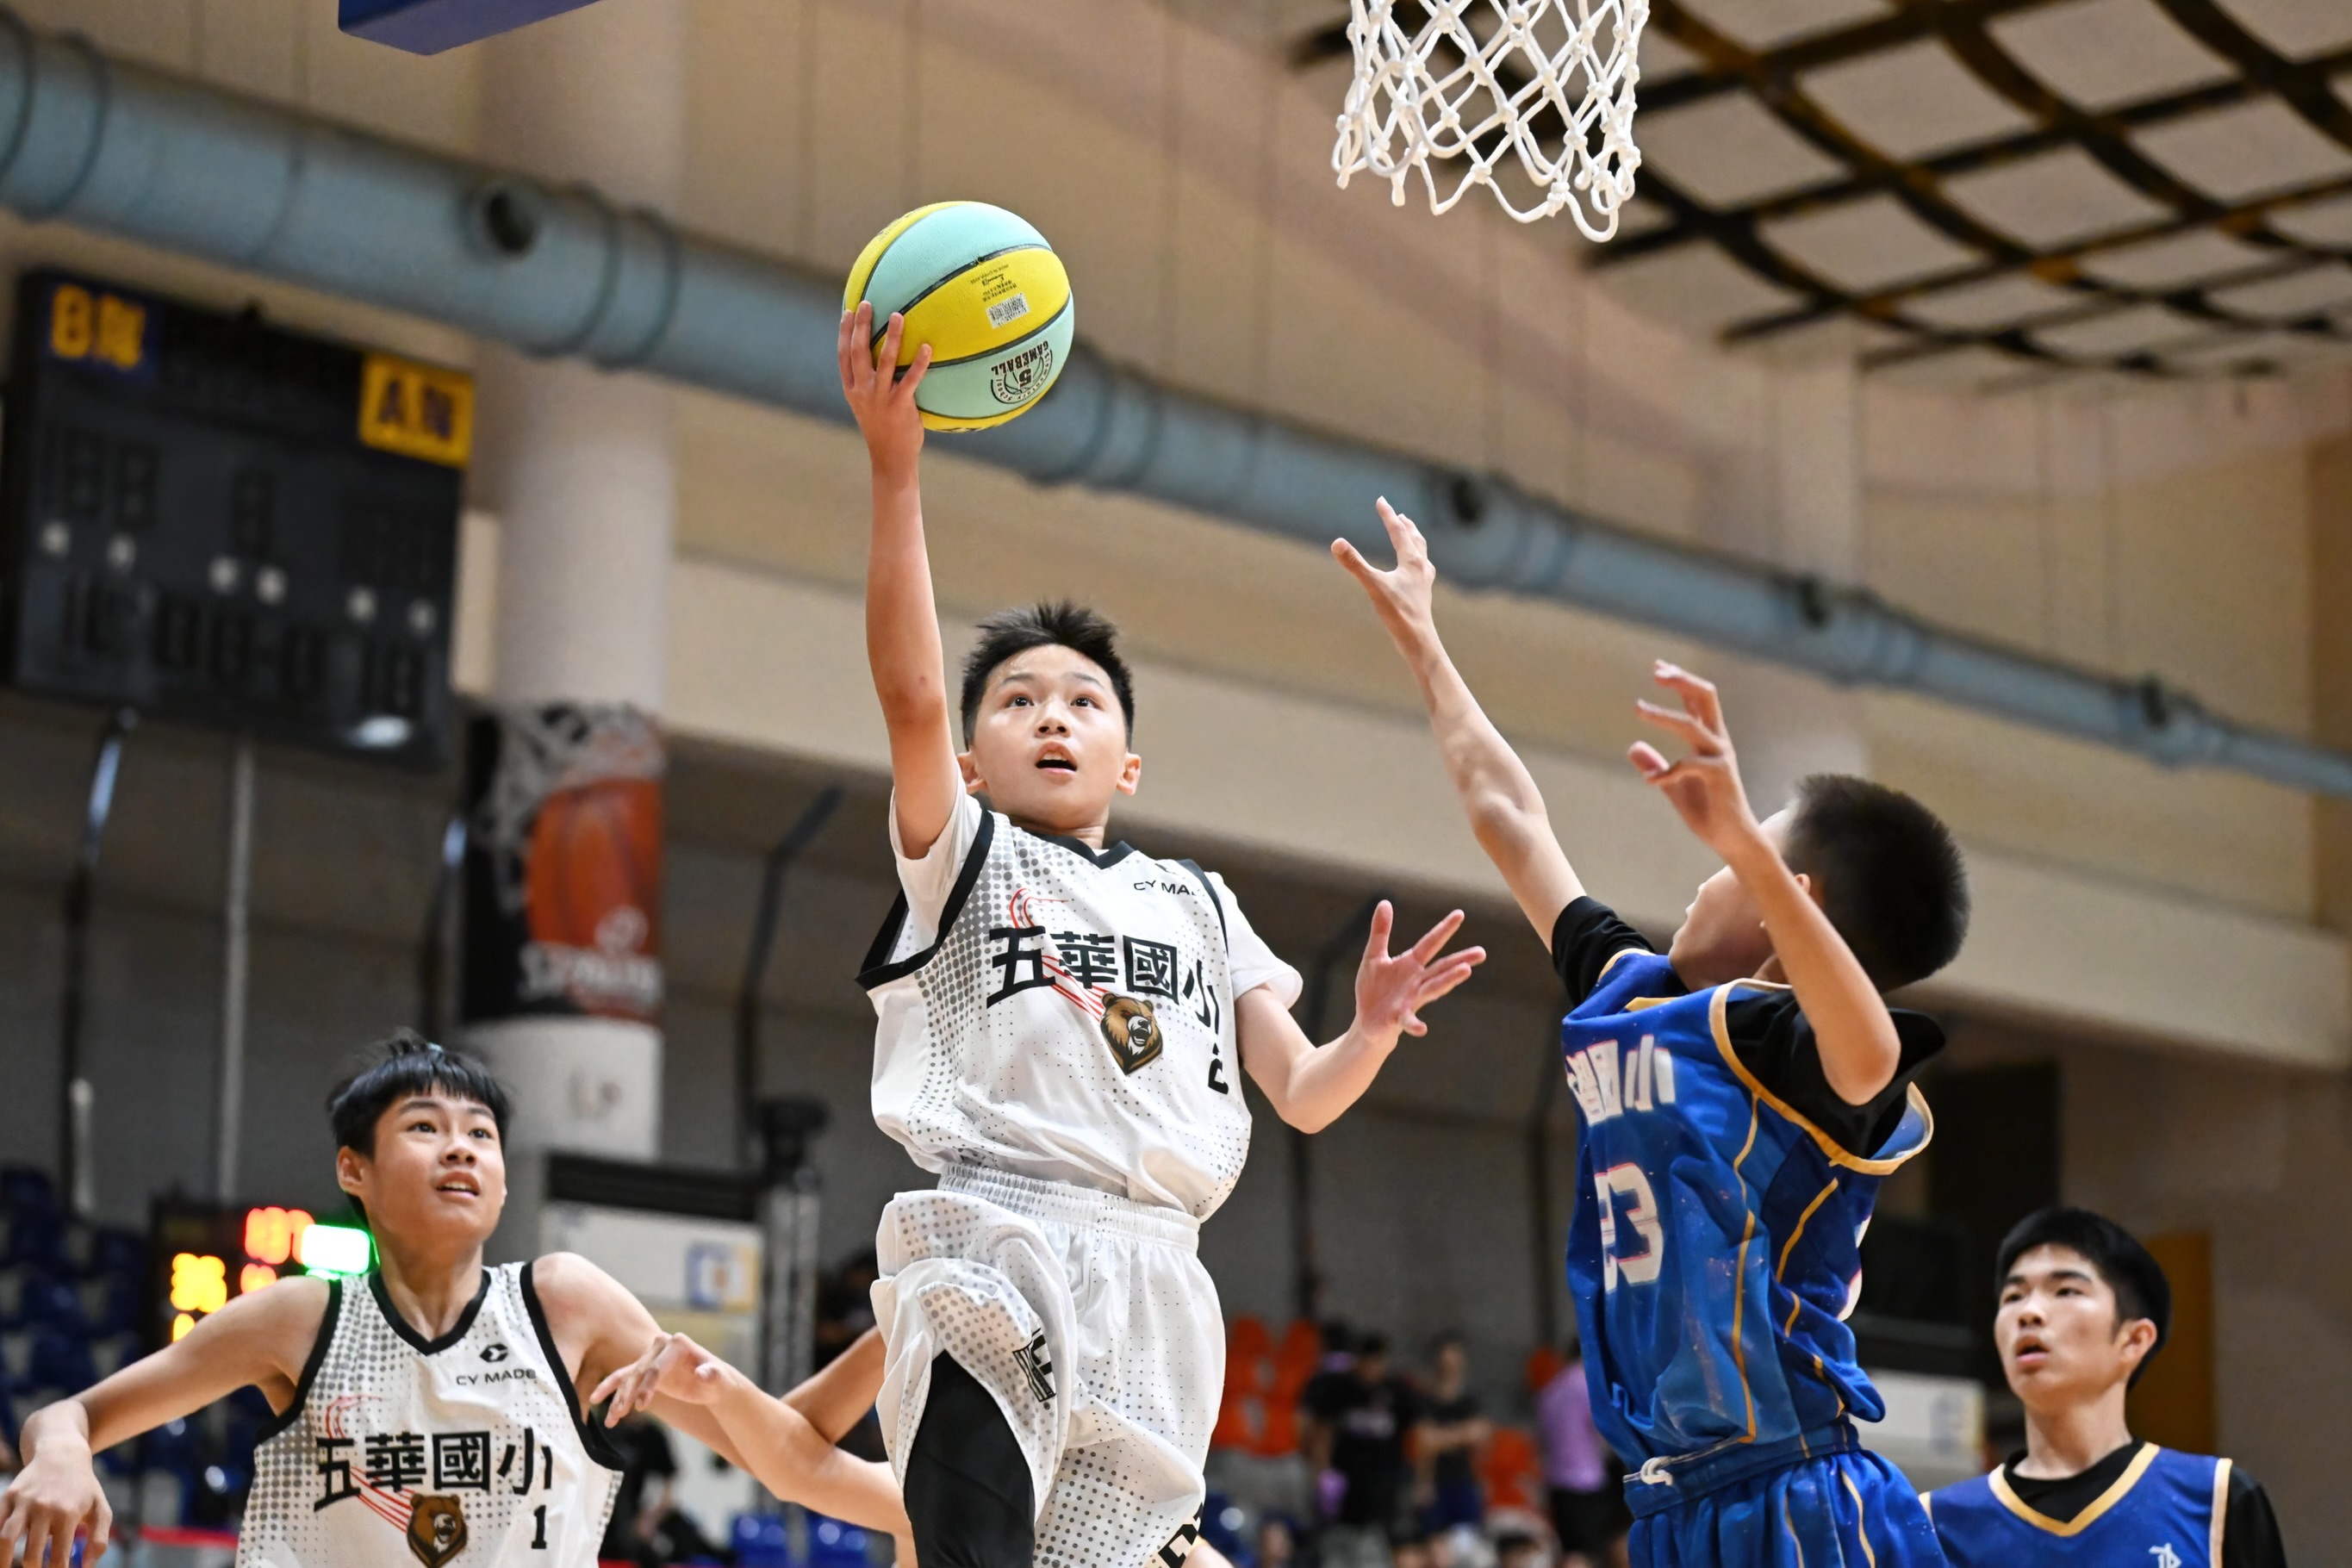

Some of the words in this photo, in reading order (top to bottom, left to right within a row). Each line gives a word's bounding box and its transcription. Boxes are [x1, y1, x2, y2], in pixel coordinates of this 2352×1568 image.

[991, 340, 1049, 376] GAMEBALL
[1017, 368, 1032, 388] 5
[1134, 880, 1156, 891] CY
[1161, 882, 1197, 896] MA
[986, 925, 1220, 1035] 五華國小
[456, 1374, 479, 1386] CY
[484, 1368, 538, 1384] MADE
[314, 1427, 552, 1512] 五華國小
[530, 1504, 548, 1550] 1
